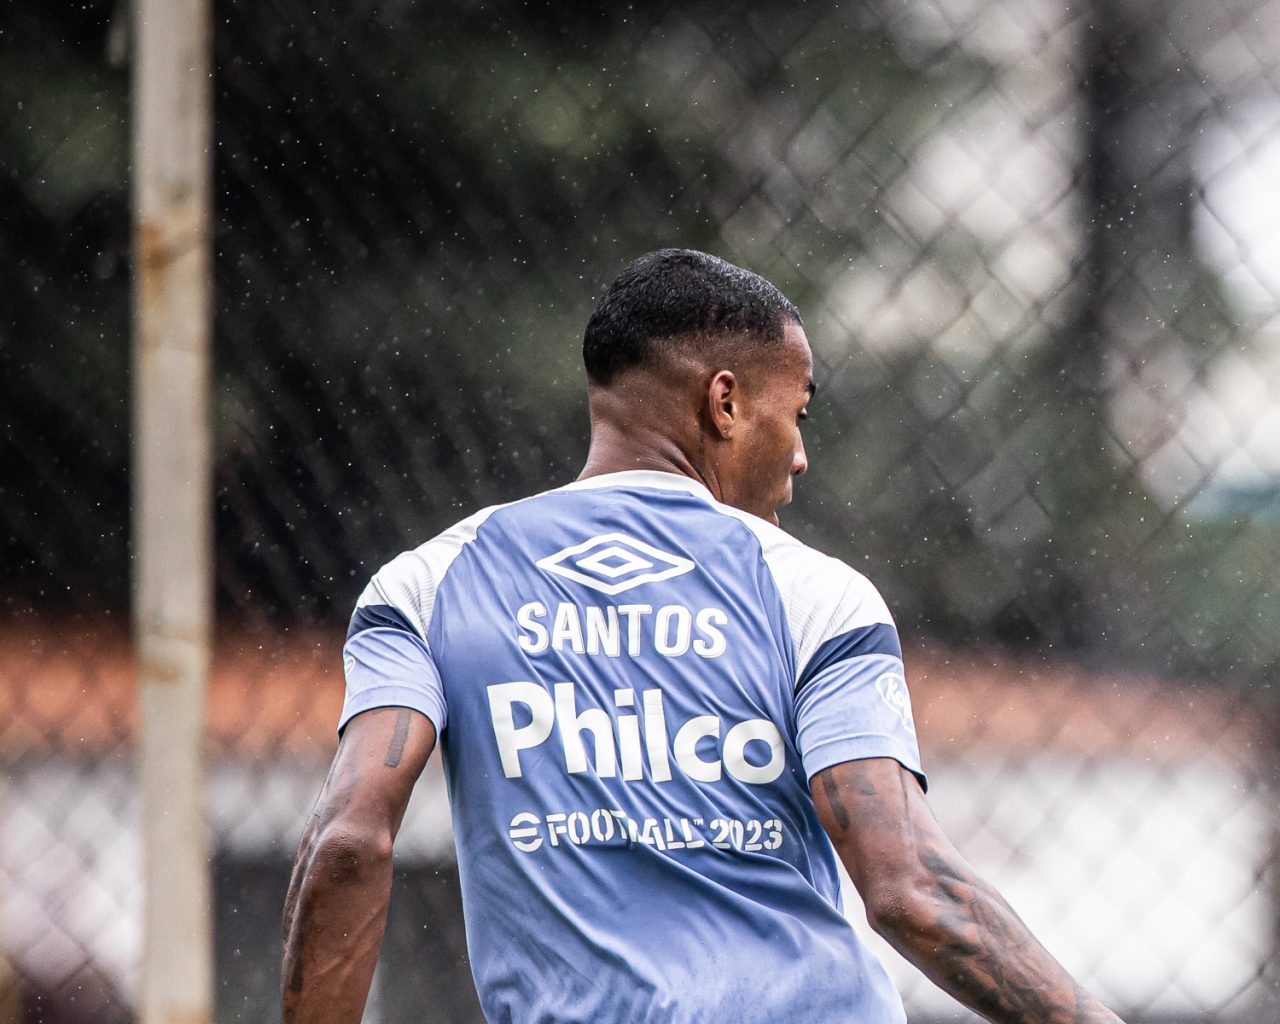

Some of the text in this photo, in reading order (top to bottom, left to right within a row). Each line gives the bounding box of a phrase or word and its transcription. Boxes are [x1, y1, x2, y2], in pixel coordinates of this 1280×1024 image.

[517, 602, 727, 658] SANTOS
[487, 681, 785, 784] Philco
[709, 818, 784, 852] 2023
